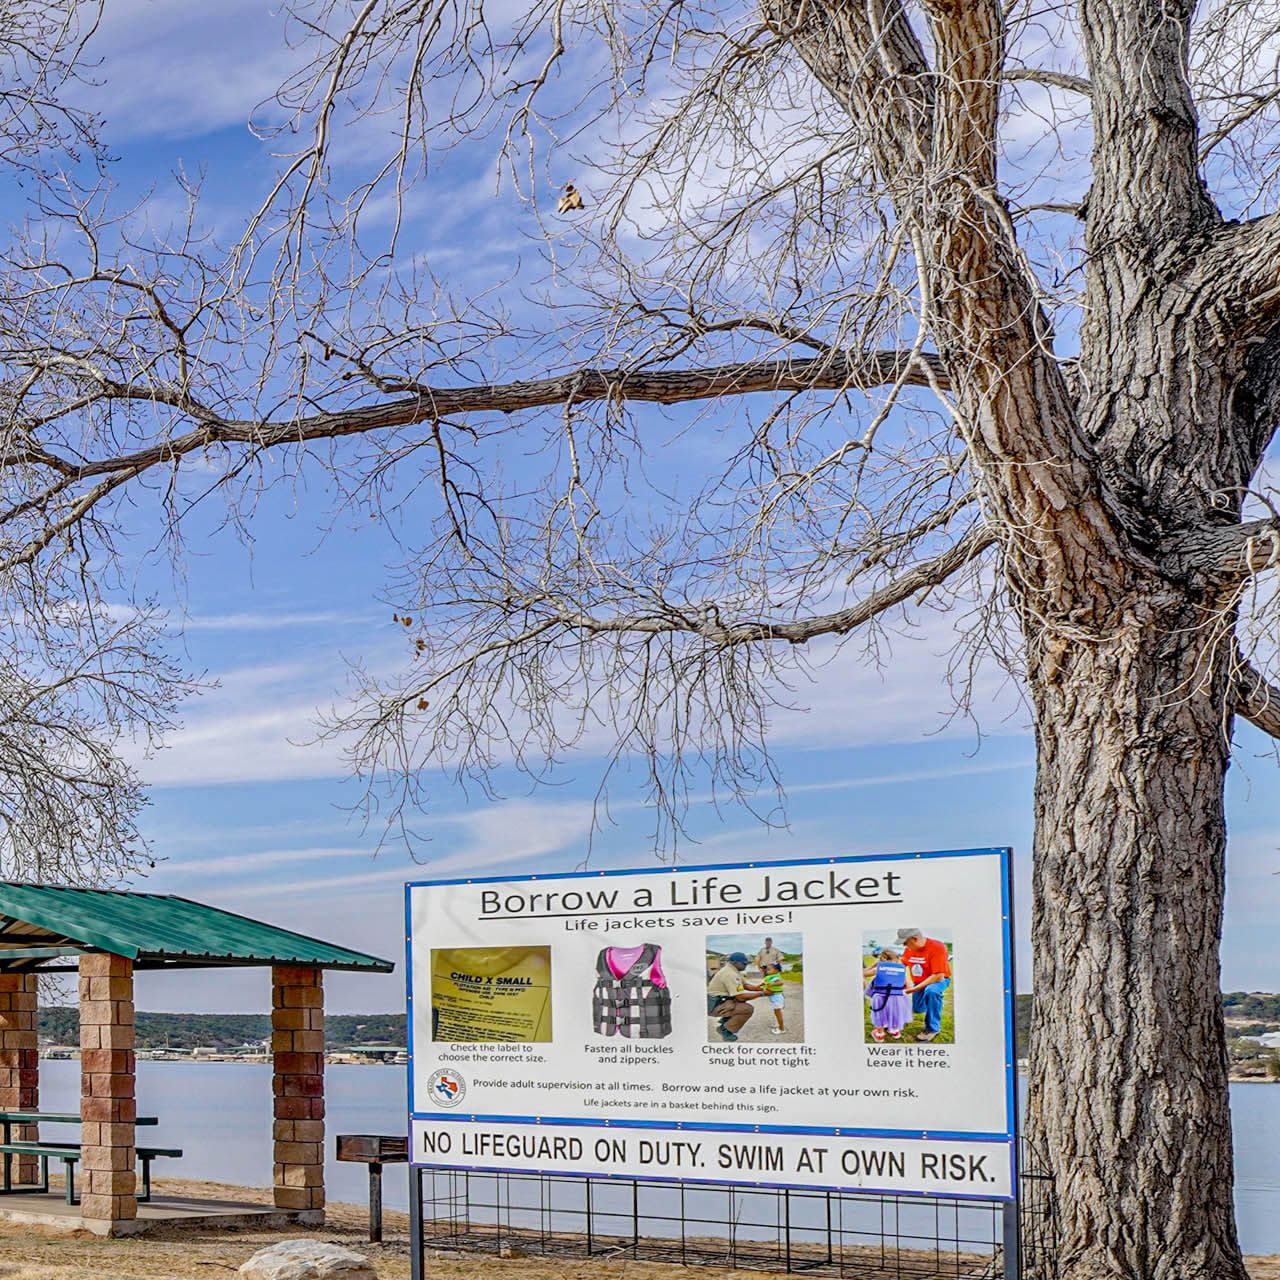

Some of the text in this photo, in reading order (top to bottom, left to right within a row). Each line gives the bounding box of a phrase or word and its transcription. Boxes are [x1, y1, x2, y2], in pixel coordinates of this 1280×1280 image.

[482, 871, 902, 913] Borrow a Life Jacket
[566, 912, 793, 932] Life jackets save lives!
[451, 972, 482, 983] CHILD
[450, 1044, 478, 1052] Check
[480, 1044, 495, 1052] the
[498, 1044, 520, 1052] label
[585, 1045, 674, 1054] Fasten all buckles
[702, 1046, 816, 1055] Check for correct fit:
[868, 1047, 949, 1056] Wear it here.
[438, 1053, 546, 1062] choose the correct size.
[598, 1055, 660, 1065] and zippers.
[709, 1058, 734, 1067] snug
[738, 1057, 757, 1066] but
[760, 1058, 780, 1066] not
[867, 1058, 950, 1068] Leave it here.
[473, 1080, 508, 1088] Provide
[510, 1080, 534, 1088] adult
[537, 1081, 592, 1090] supervision
[595, 1082, 605, 1090] at
[608, 1082, 620, 1090] all
[622, 1082, 654, 1092] times.
[662, 1083, 701, 1092] Borrow
[704, 1085, 724, 1094] and
[759, 1085, 776, 1094] life
[780, 1086, 814, 1096] jacket
[832, 1088, 860, 1098] your
[893, 1088, 919, 1098] risk.
[584, 1099, 599, 1107] Life
[601, 1100, 632, 1109] jackets
[670, 1101, 699, 1109] basket
[702, 1102, 734, 1110] behind
[737, 1103, 754, 1111] this
[756, 1104, 779, 1113] sign.
[424, 1131, 996, 1182] NO LIFEGUARD ON DUTY. SWIM AT OWN RISK.
